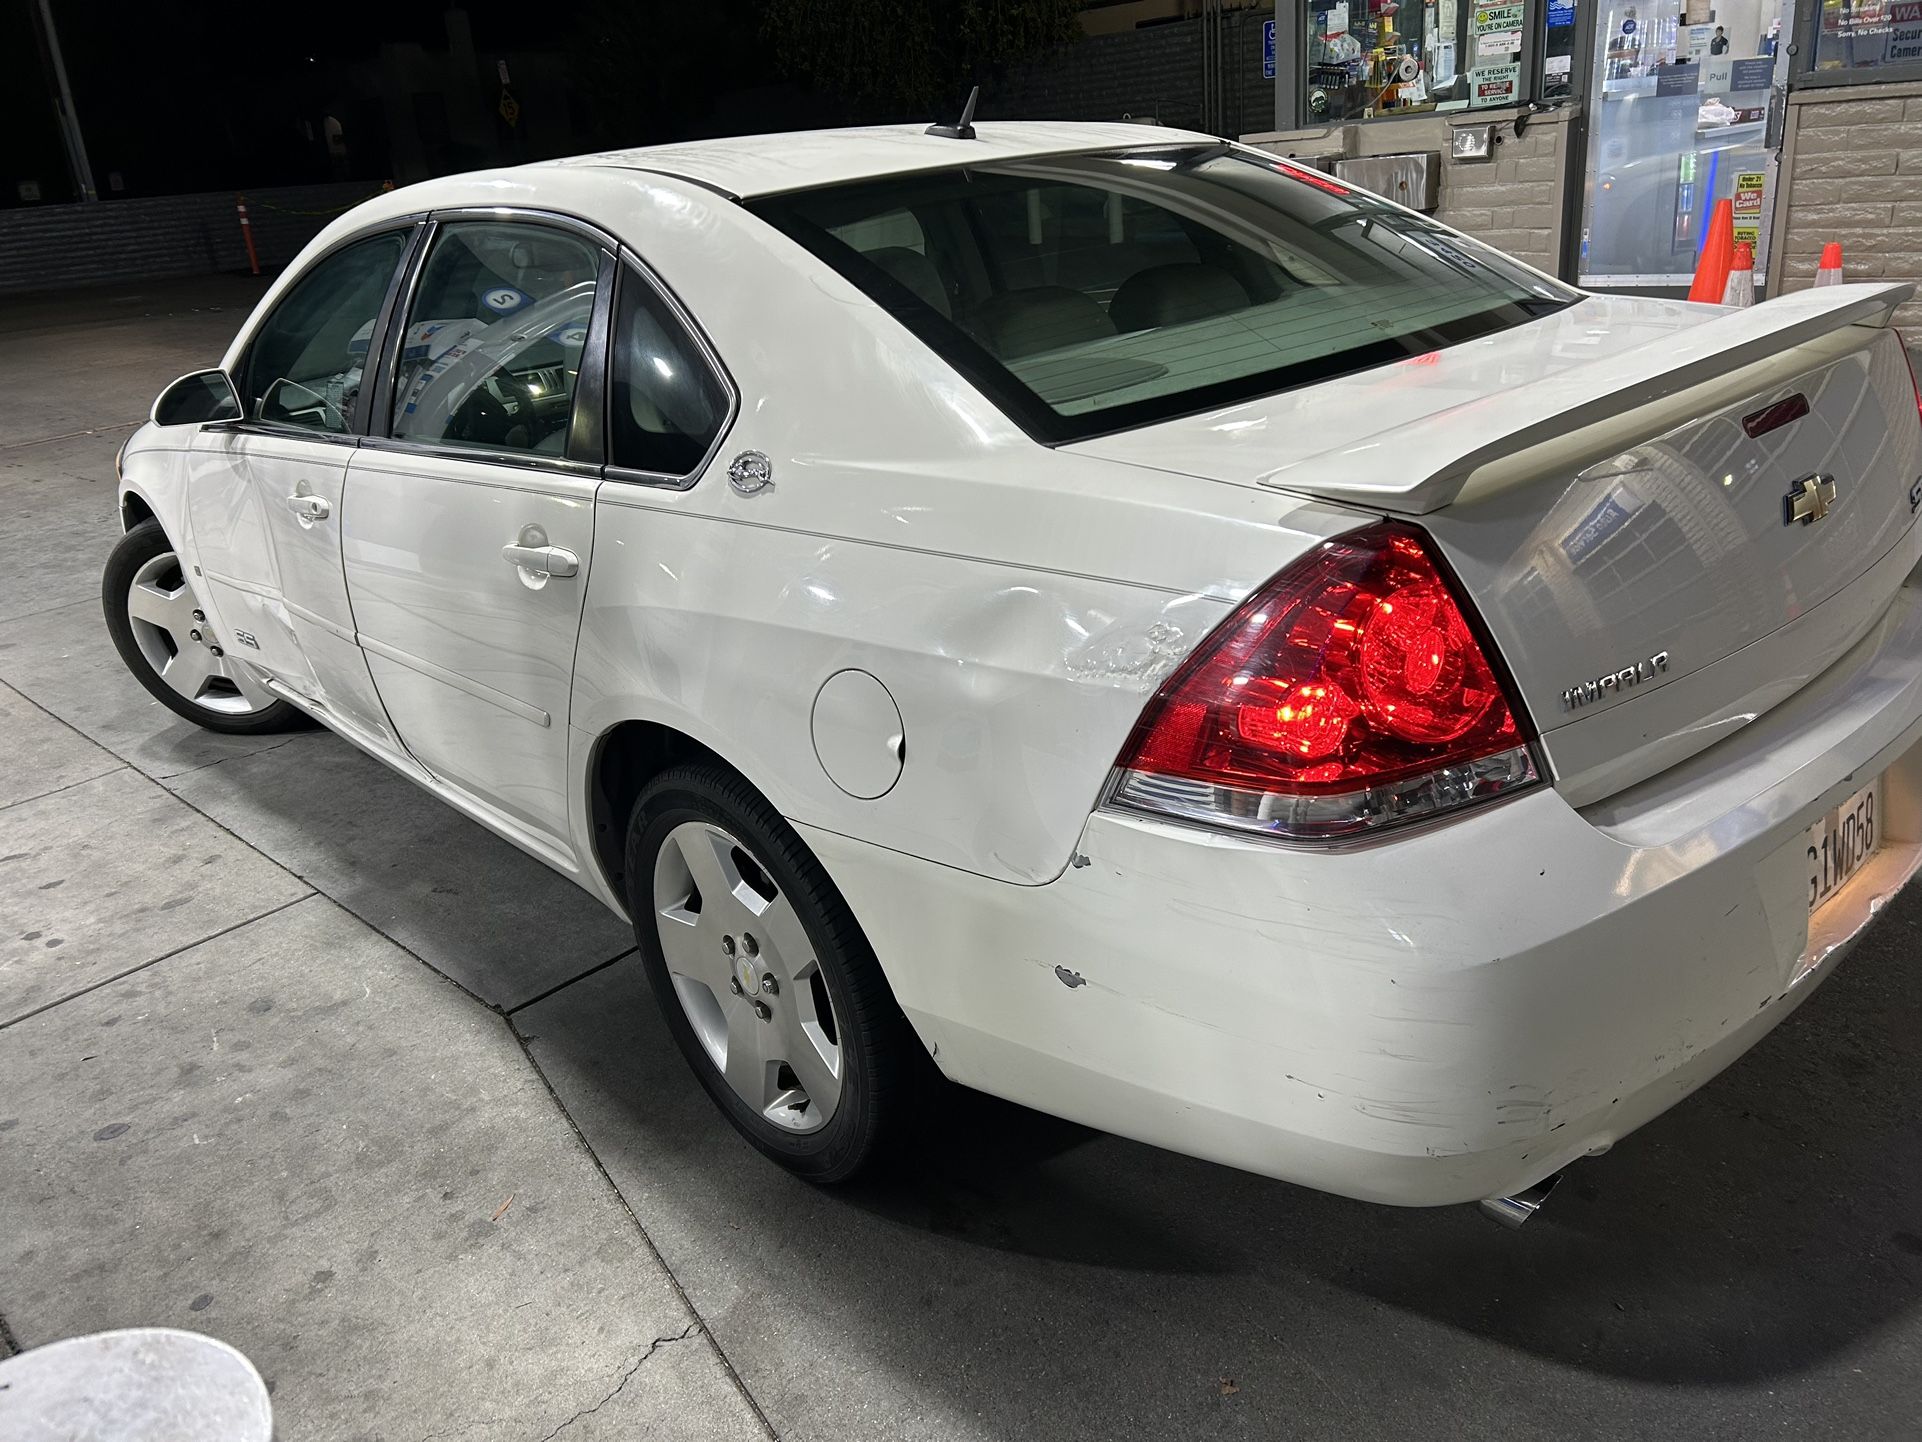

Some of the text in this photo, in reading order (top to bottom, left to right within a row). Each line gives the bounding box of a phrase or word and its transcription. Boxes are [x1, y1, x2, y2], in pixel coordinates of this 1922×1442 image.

[1489, 9, 1512, 21] SMILE
[1494, 22, 1502, 30] ON
[1503, 19, 1523, 29] CAMERA
[1487, 66, 1517, 76] RESERVE
[1709, 72, 1728, 81] Pull
[1740, 192, 1757, 200] We
[1735, 198, 1761, 208] Card
